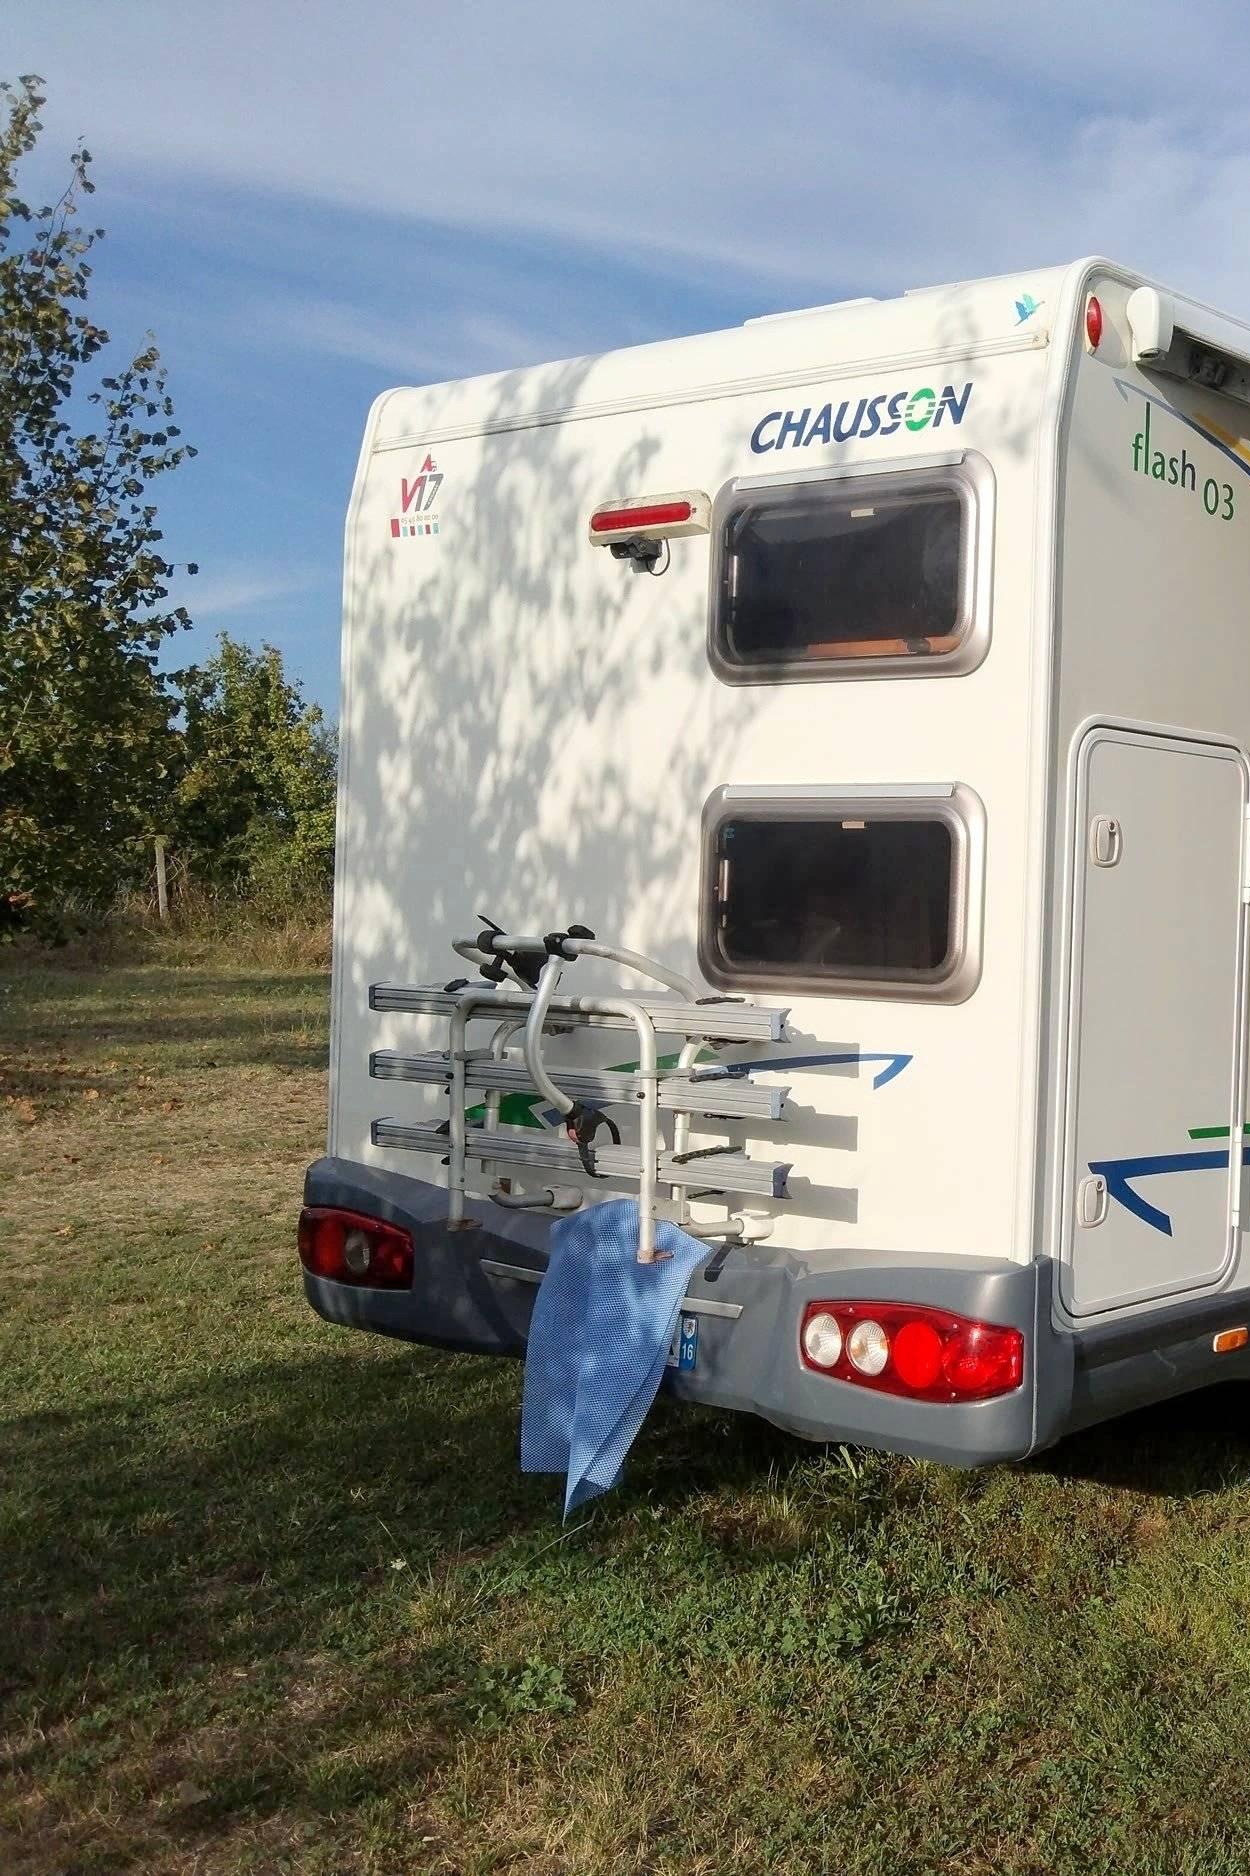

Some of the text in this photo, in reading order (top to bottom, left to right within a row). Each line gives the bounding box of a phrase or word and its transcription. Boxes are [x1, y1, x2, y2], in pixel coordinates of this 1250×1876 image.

[751, 382, 974, 454] CHAUSSON
[1132, 401, 1234, 521] flash 03
[681, 1343, 694, 1361] 16
